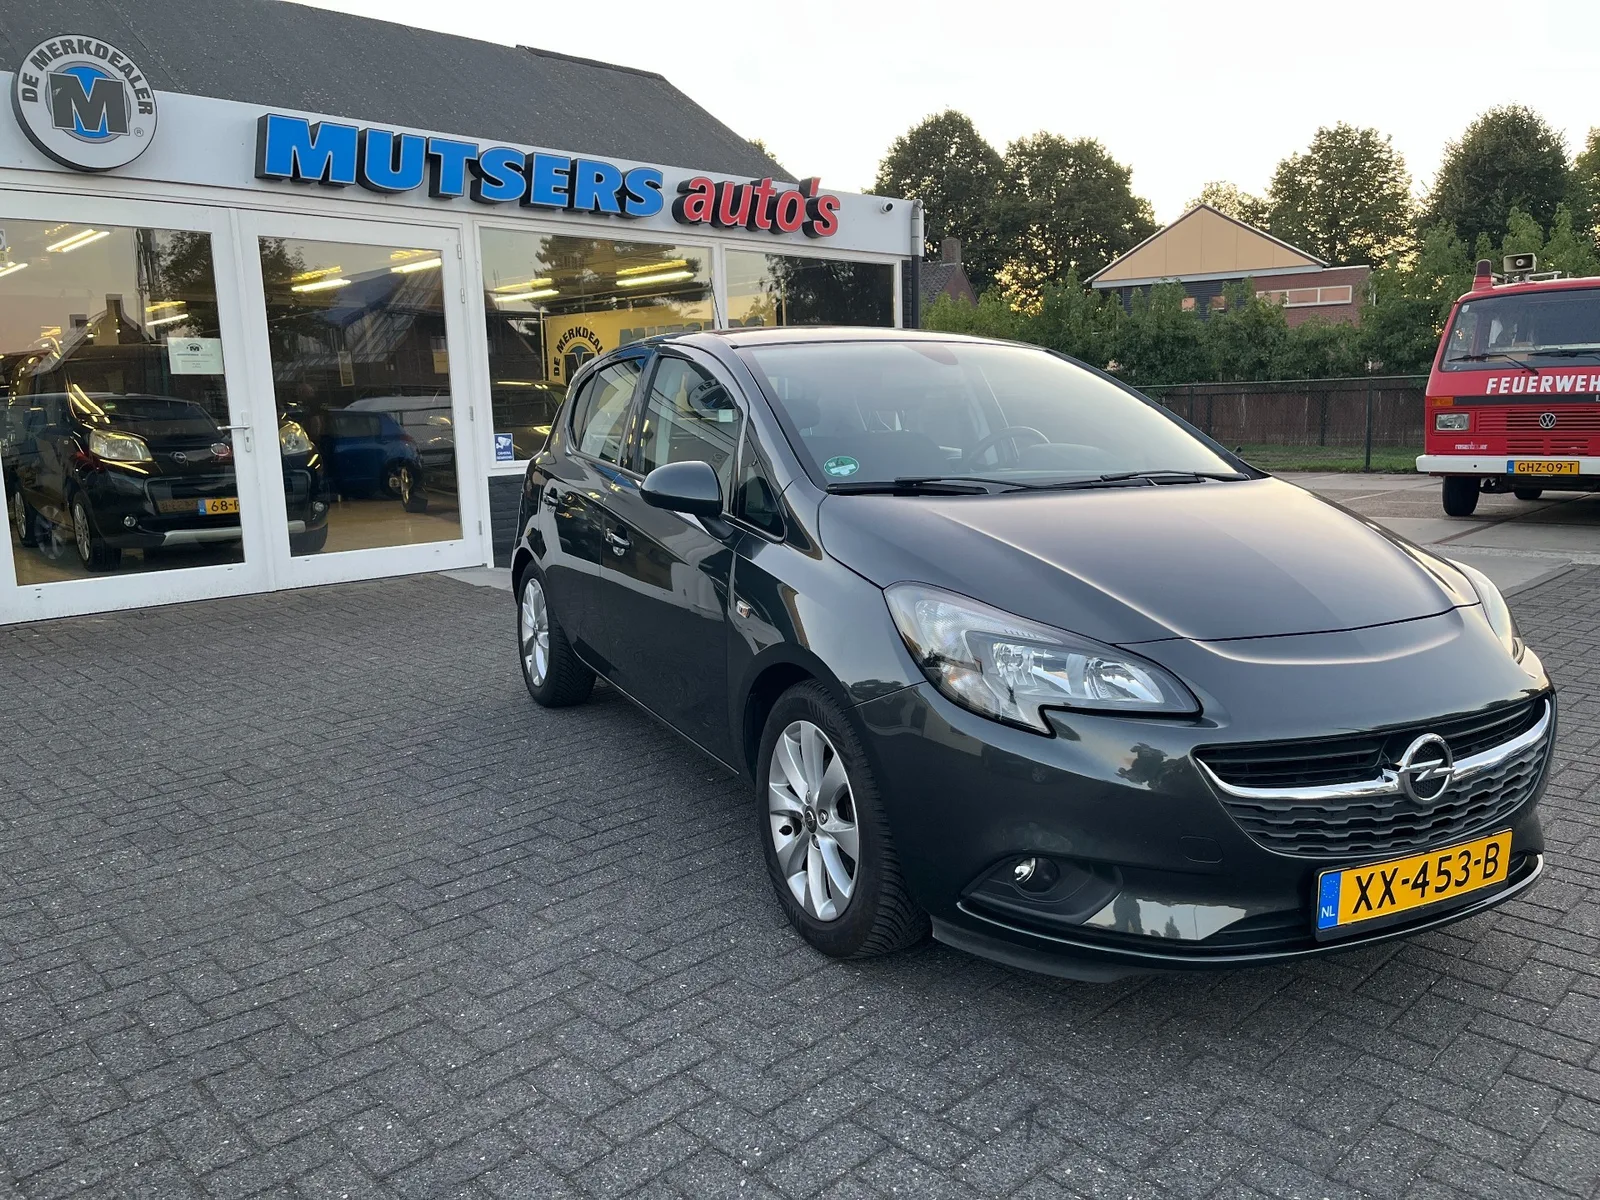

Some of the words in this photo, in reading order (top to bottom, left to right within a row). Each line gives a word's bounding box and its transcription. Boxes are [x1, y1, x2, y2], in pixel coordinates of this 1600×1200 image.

[22, 72, 39, 103] DE
[29, 38, 153, 115] MERKDEALER
[47, 71, 130, 136] M
[259, 113, 664, 219] MUTSERS
[676, 176, 841, 238] auto's
[553, 357, 561, 376] DE
[1486, 375, 1600, 394] FEUERWEH
[1518, 462, 1575, 472] GHZ-09-T
[1352, 842, 1500, 914] XX-453-B
[1321, 906, 1336, 919] NL
